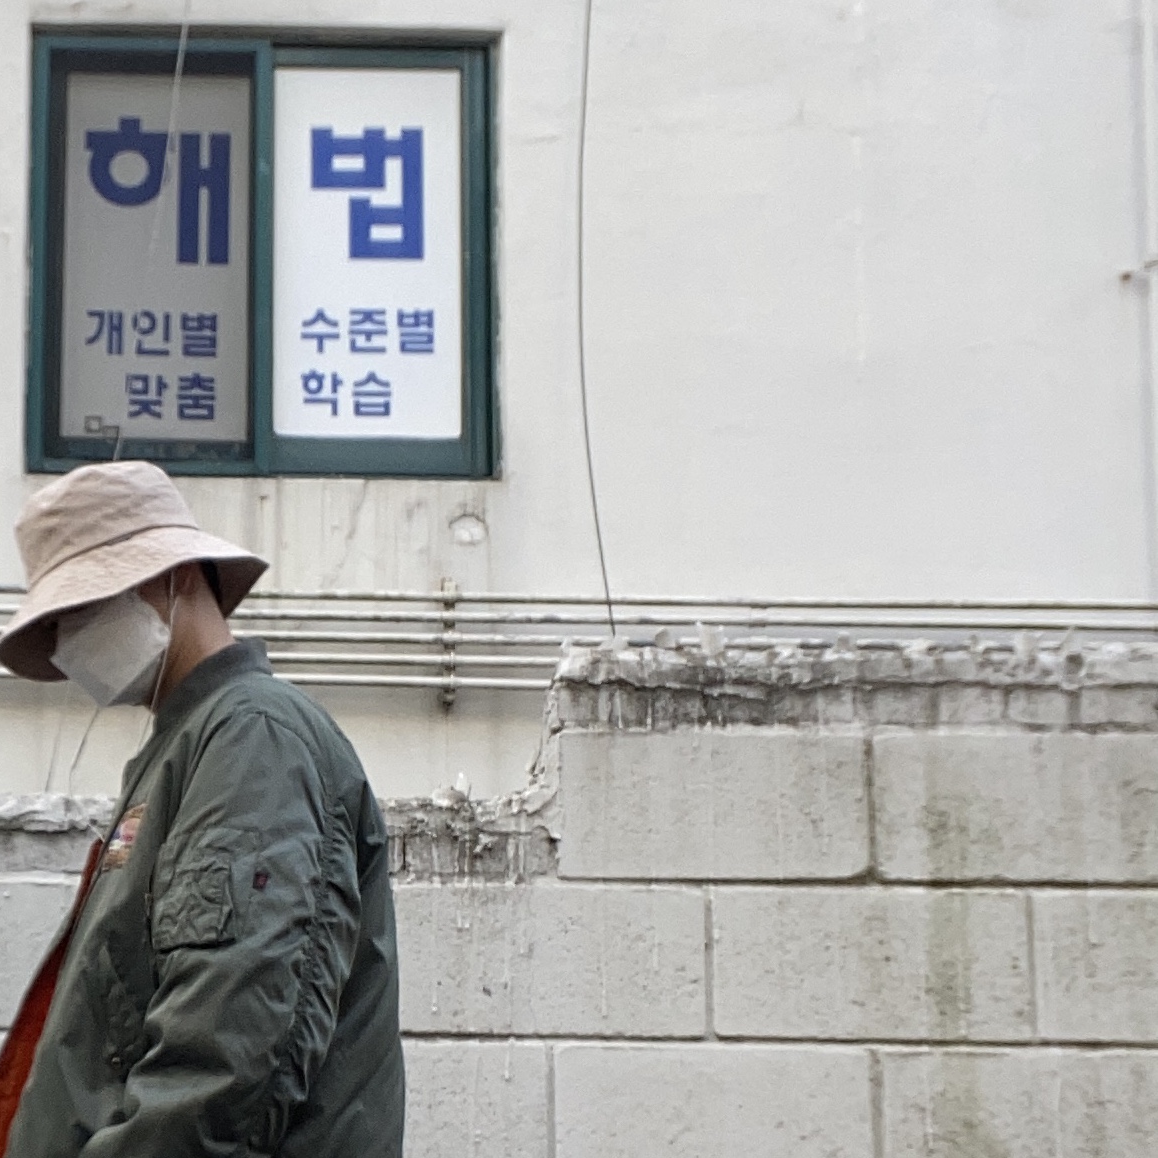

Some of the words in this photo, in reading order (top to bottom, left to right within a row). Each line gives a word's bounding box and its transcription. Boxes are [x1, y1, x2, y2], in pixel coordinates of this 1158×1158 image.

[85, 309, 218, 358] 개인별
[300, 307, 435, 354] 수준별
[125, 373, 216, 420] 맞춤
[300, 369, 392, 417] 학습
